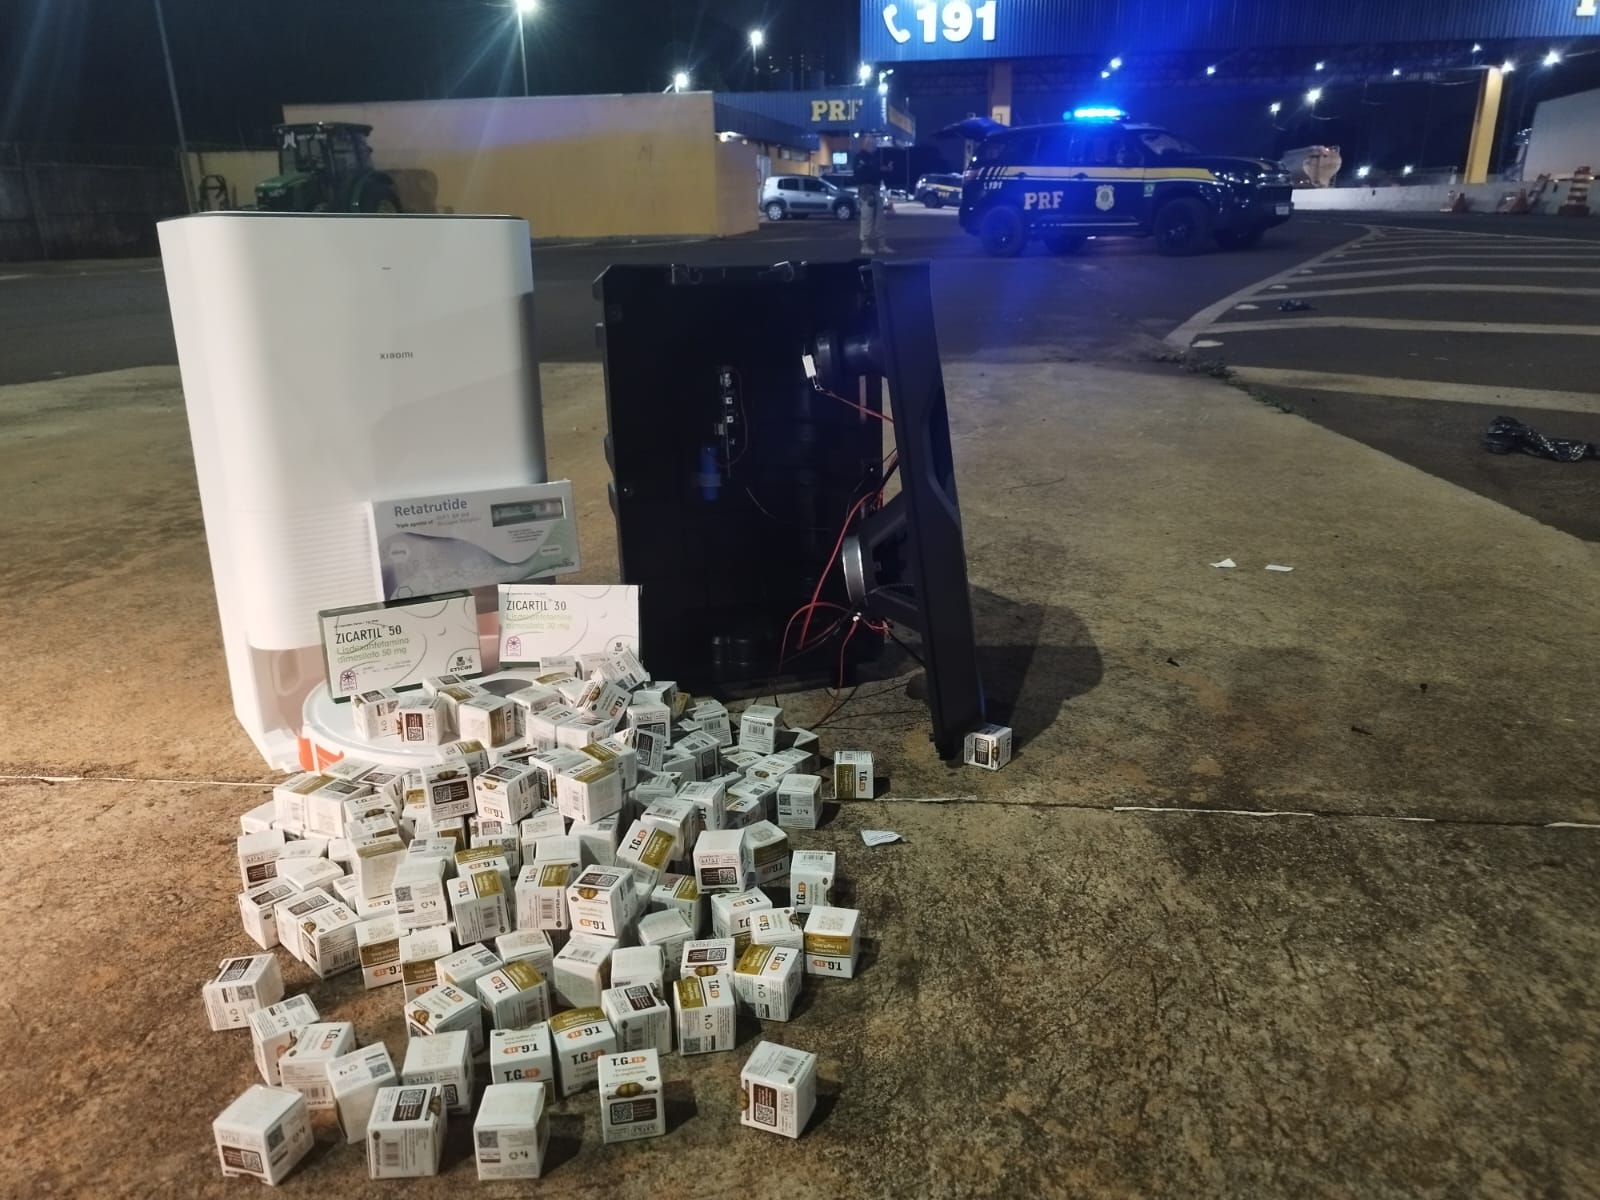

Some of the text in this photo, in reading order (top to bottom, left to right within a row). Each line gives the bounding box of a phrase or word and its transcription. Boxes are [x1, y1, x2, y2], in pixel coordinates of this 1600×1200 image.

[916, 0, 997, 42] 191
[811, 98, 863, 121] PRF
[1023, 191, 1064, 210] PRF
[394, 498, 468, 517] Retatrutide
[506, 600, 567, 611] ZICARTIL 30
[335, 627, 383, 645] ZICARTIL
[388, 624, 402, 636] 50
[393, 646, 407, 656] mg
